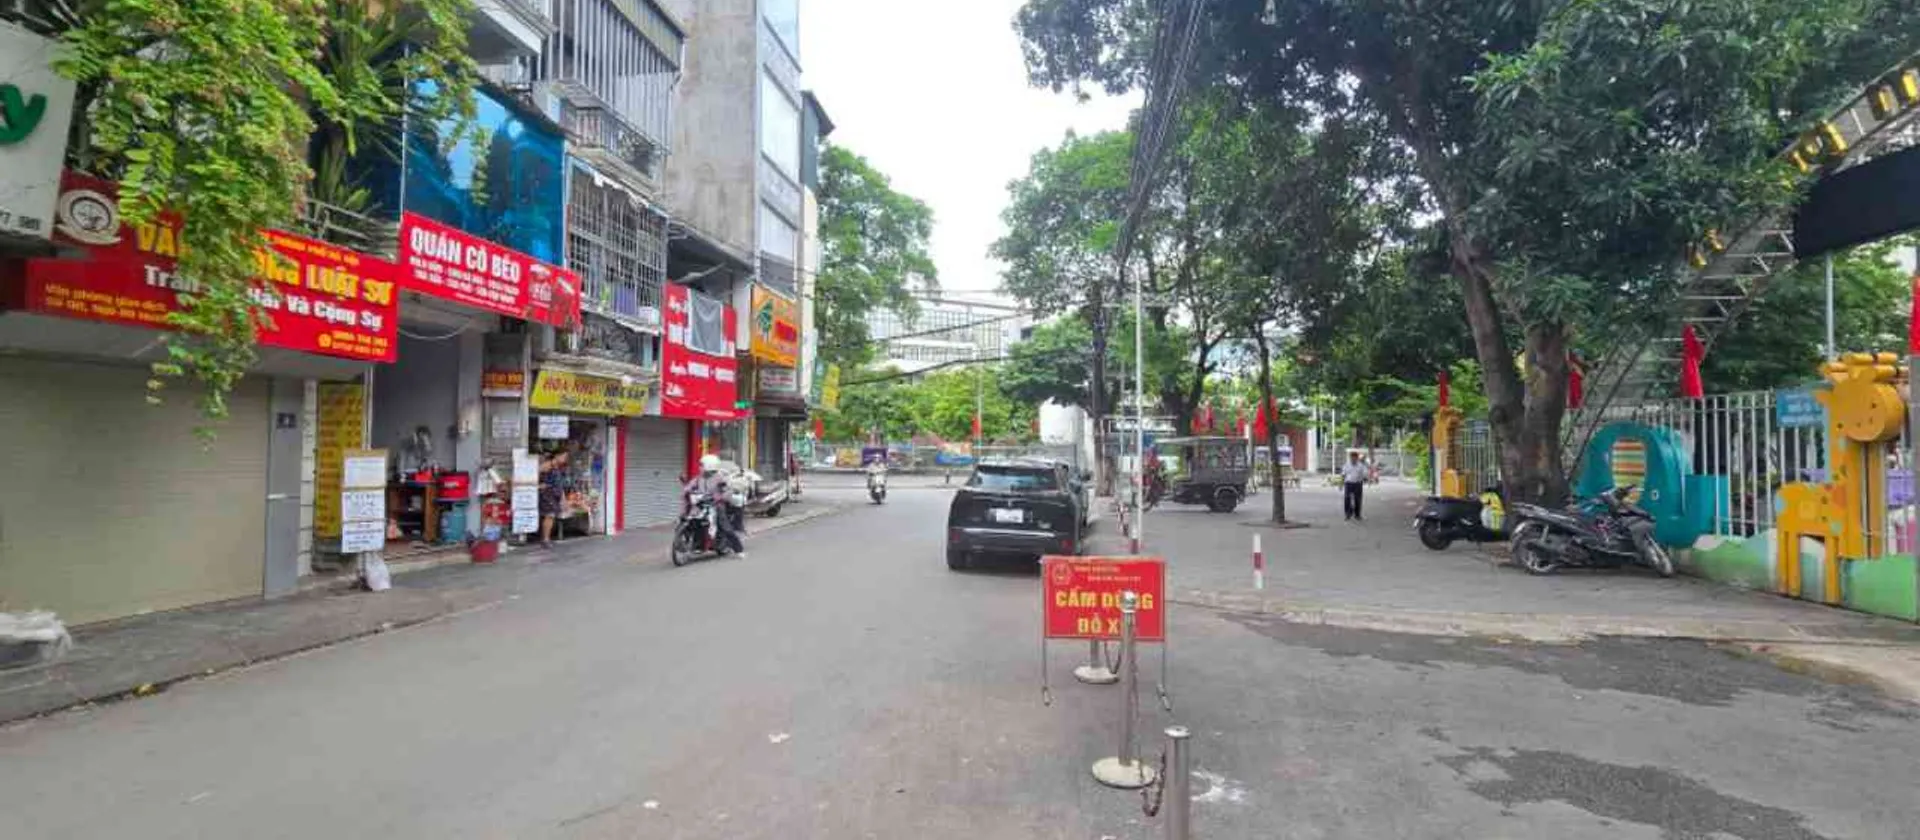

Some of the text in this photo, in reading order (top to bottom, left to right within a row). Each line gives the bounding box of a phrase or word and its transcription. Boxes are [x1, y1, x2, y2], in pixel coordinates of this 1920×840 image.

[410, 226, 461, 266] QUÁN
[491, 252, 521, 284] BÉO
[306, 263, 360, 300] LUẬT
[362, 278, 395, 307] SƯ
[286, 293, 310, 316] Và
[313, 300, 357, 326] Cộng
[1056, 585, 1097, 608] CẤM
